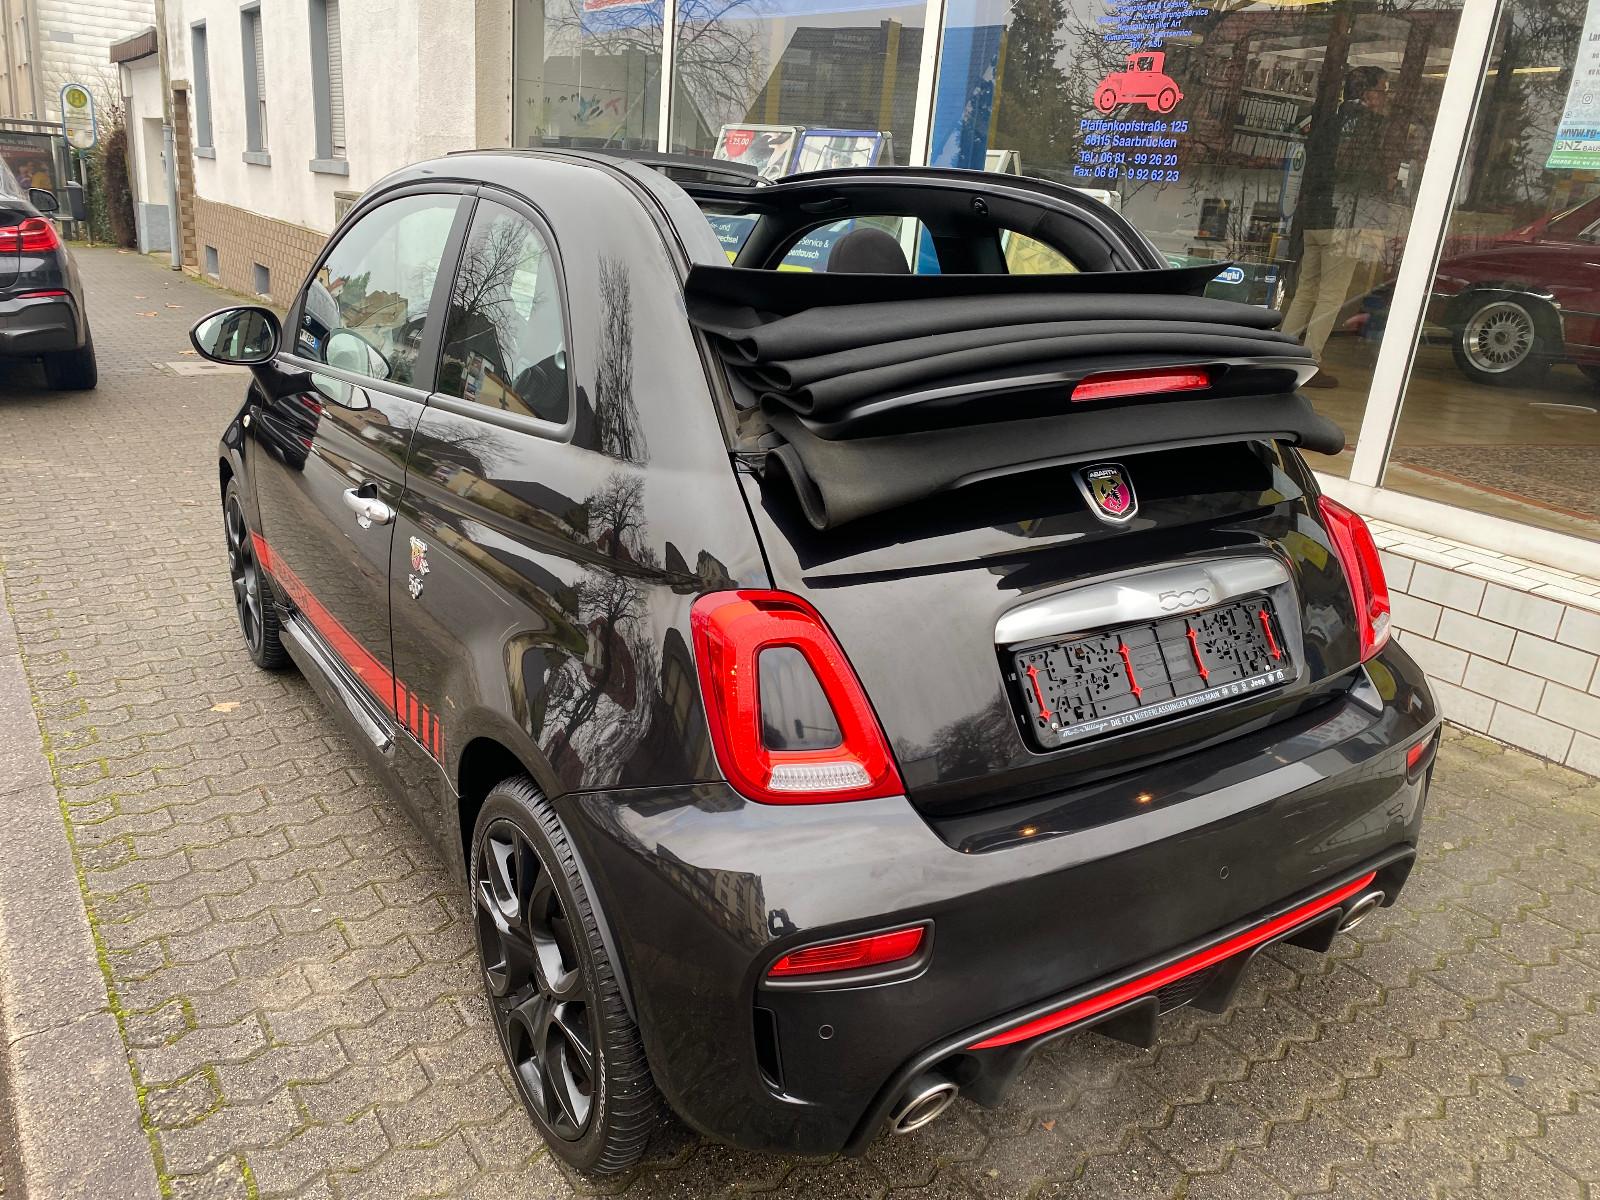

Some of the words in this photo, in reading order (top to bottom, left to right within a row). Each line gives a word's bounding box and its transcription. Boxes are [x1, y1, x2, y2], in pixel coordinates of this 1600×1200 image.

[1080, 120, 1167, 133] Pfaffenkopfstraße
[1170, 121, 1188, 132] 125
[1112, 135, 1177, 148] Saarbrücken
[1081, 151, 1098, 162] Tel.:
[1101, 152, 1112, 163] 06
[1114, 152, 1125, 163] 81
[1135, 154, 1147, 164] 99
[1149, 154, 1162, 165] 26
[1163, 155, 1178, 166] 20
[1073, 165, 1092, 177] Fax:
[1094, 166, 1106, 177] 06
[1108, 167, 1118, 178] 81
[1128, 168, 1135, 179] 9
[1136, 169, 1149, 180] 92
[1151, 169, 1164, 181] 62
[1166, 170, 1179, 182] 23
[1089, 469, 1117, 478] ABARTH
[1159, 587, 1210, 611] 500
[1110, 718, 1122, 727] DIE
[1122, 715, 1135, 724] FCA
[1135, 700, 1188, 721] NIEDERLASSUNGEN
[1188, 691, 1221, 706] RHEIN-MAIN
[1250, 678, 1266, 687] Jeep
